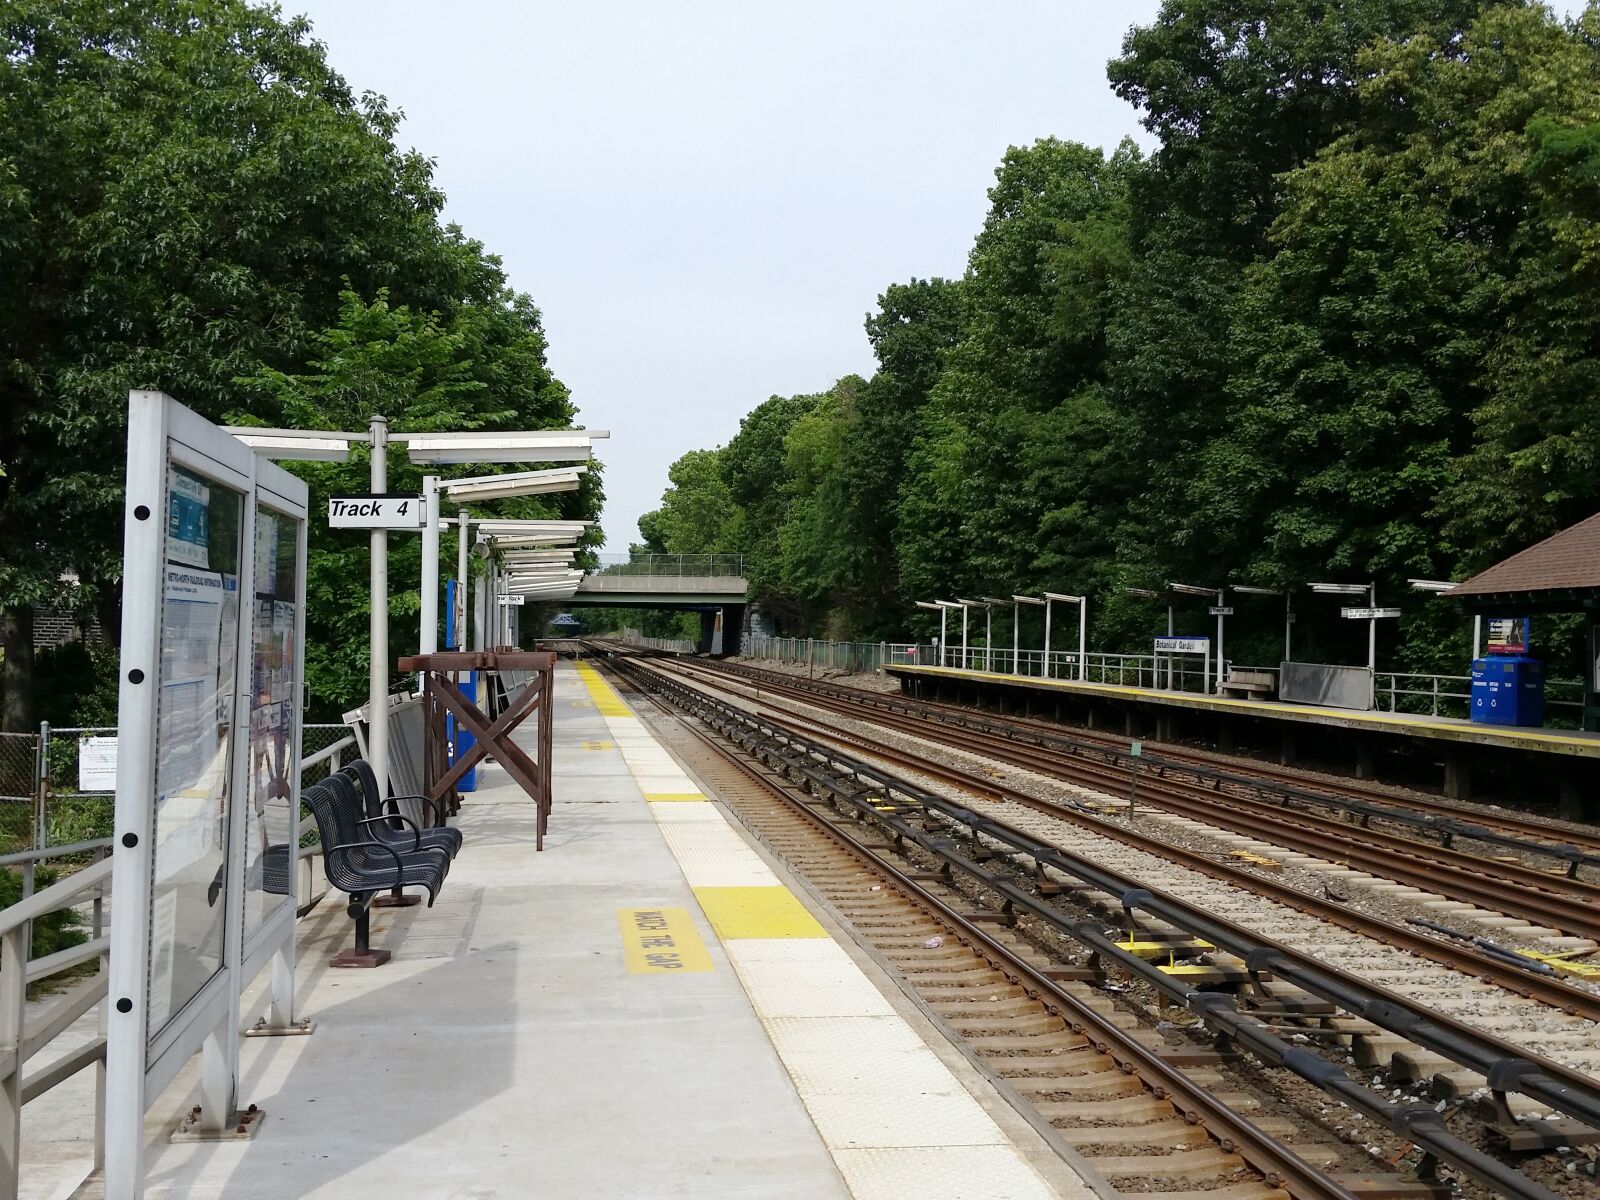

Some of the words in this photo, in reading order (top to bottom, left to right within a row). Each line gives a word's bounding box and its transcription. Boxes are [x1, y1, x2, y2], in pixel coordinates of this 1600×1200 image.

[331, 500, 382, 517] Track
[396, 501, 408, 517] 4
[1156, 640, 1177, 649] Botanical
[1179, 641, 1195, 650] Garden
[634, 911, 669, 931] WATCH
[640, 934, 675, 948] THE
[645, 953, 684, 969] GAP
